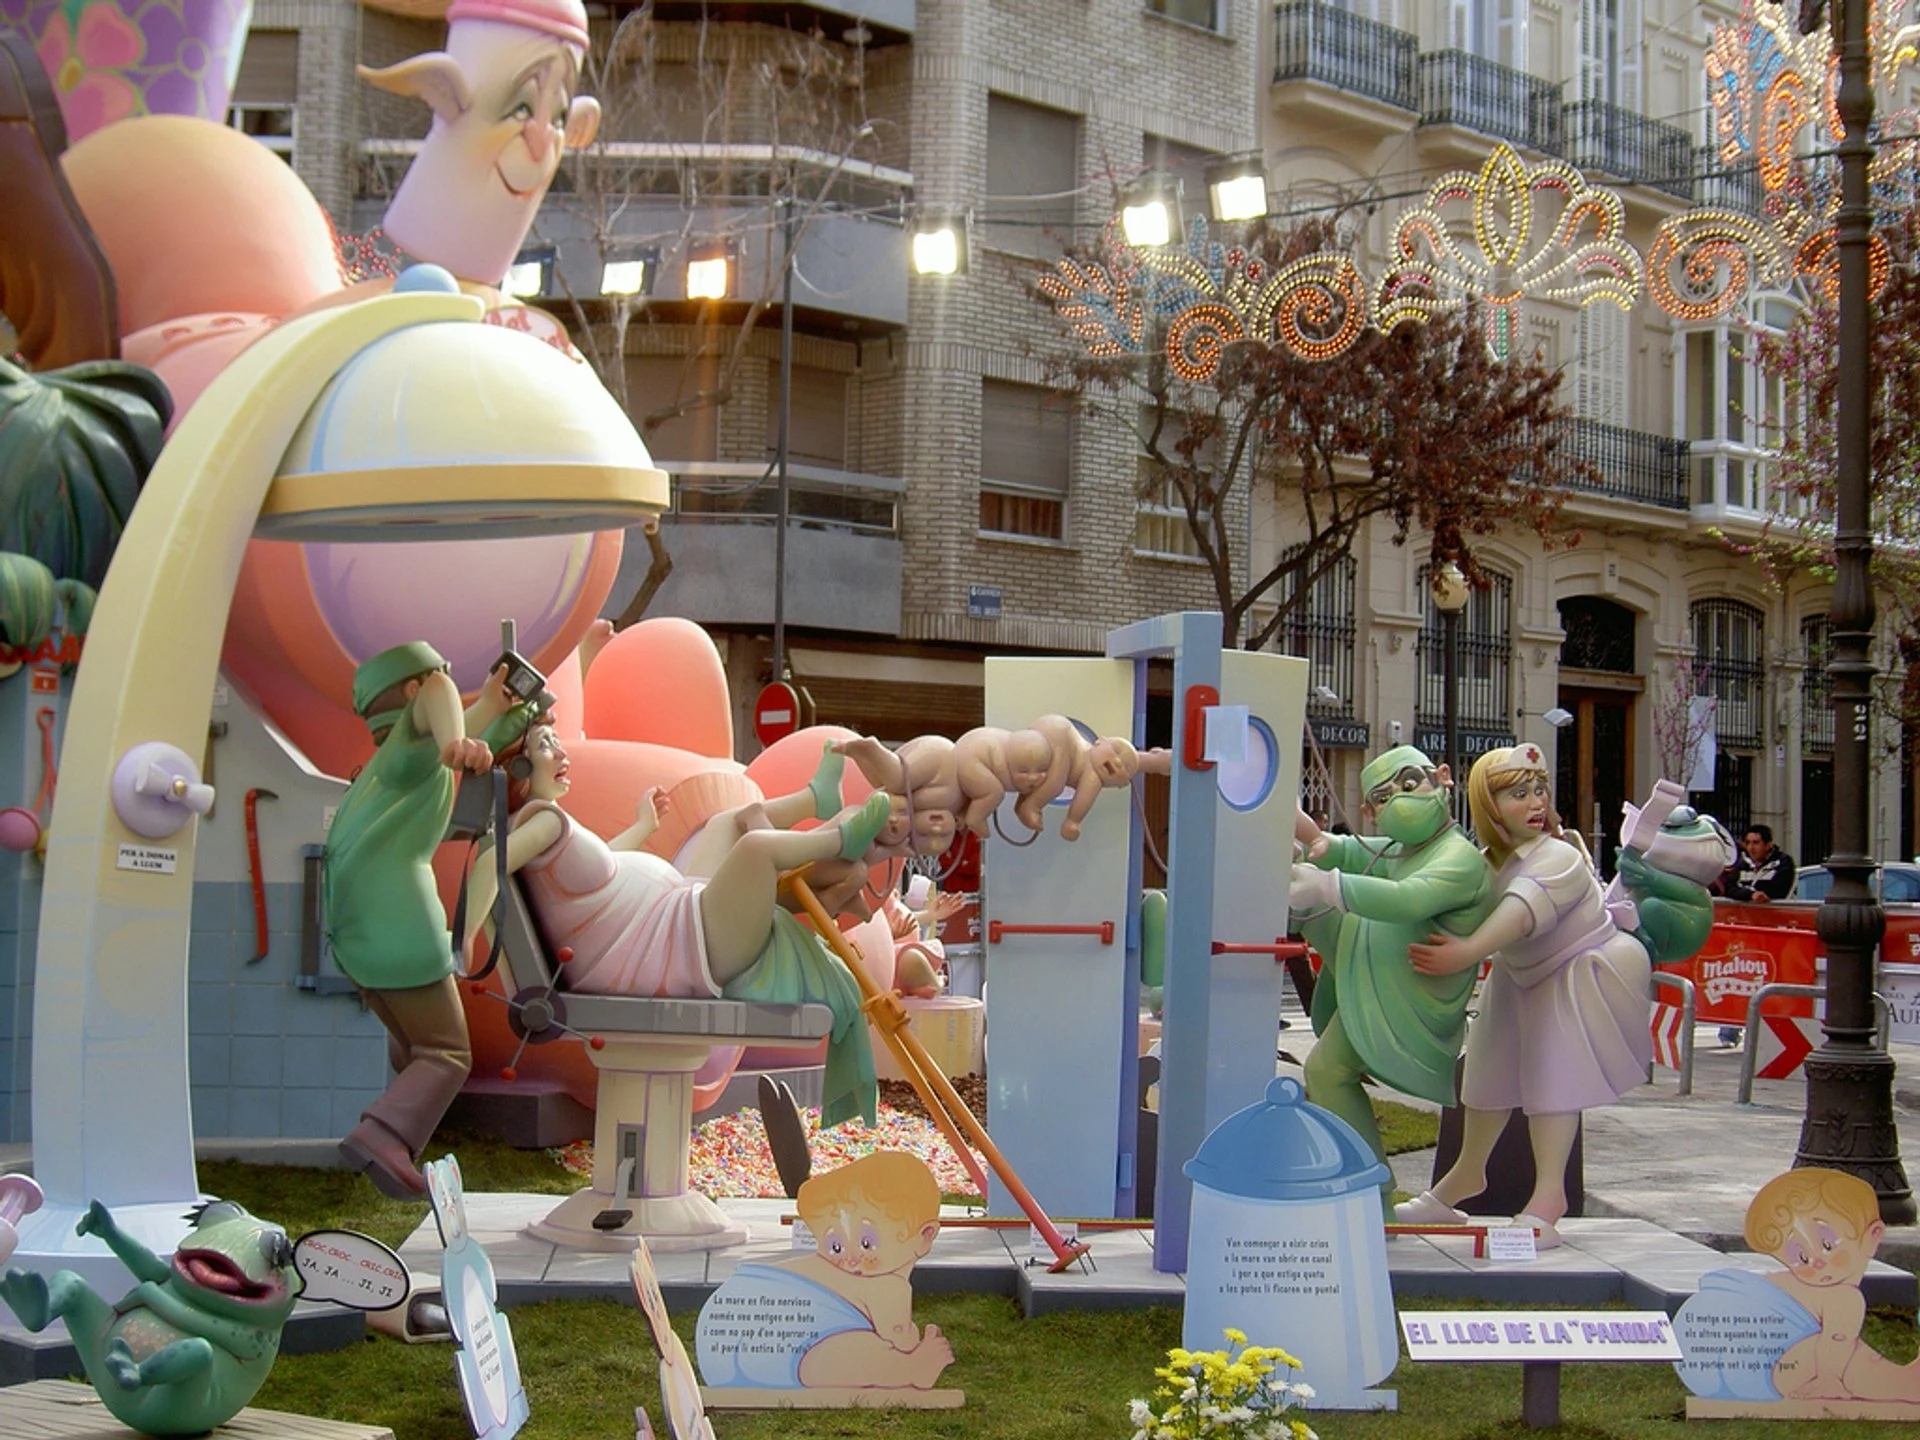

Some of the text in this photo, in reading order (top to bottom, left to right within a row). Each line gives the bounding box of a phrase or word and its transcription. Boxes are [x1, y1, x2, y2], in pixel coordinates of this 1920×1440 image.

[1321, 725, 1367, 744] DECOR
[1703, 955, 1768, 979] Mahou
[1226, 1237, 1241, 1248] Van
[1243, 1240, 1280, 1250] començar
[1231, 1252, 1239, 1263] la
[1241, 1255, 1260, 1263] mare
[1262, 1255, 1276, 1263] van
[1278, 1252, 1298, 1263] obrir
[1300, 1255, 1310, 1263] en
[1312, 1253, 1333, 1263] canal
[1238, 1270, 1251, 1281] per
[1261, 1271, 1274, 1281] que
[1277, 1270, 1301, 1281] estiga
[1226, 1283, 1238, 1293] les
[1240, 1284, 1262, 1296] potes
[1273, 1283, 1300, 1294] ficaren
[1302, 1286, 1312, 1294] un
[1314, 1284, 1340, 1296] puntal
[714, 1294, 723, 1305] La
[725, 1297, 745, 1306] mare
[747, 1298, 757, 1306] es
[759, 1295, 775, 1306] fica
[753, 1312, 782, 1325] metges
[797, 1312, 815, 1323] bata
[1685, 1312, 1694, 1323] El
[728, 1329, 738, 1337] no
[740, 1329, 755, 1340] sap
[776, 1330, 819, 1340] agarrar-se
[1406, 1323, 1437, 1345] EL
[1441, 1322, 1500, 1345] LLOC
[1504, 1322, 1536, 1345] DE
[1539, 1322, 1573, 1345] LA
[1685, 1327, 1789, 1341] els altres aguanten la mare
[711, 1342, 719, 1352] al
[721, 1344, 739, 1355] pare
[750, 1343, 774, 1353] estira
[776, 1342, 785, 1353] la
[1727, 1360, 1740, 1370] set
